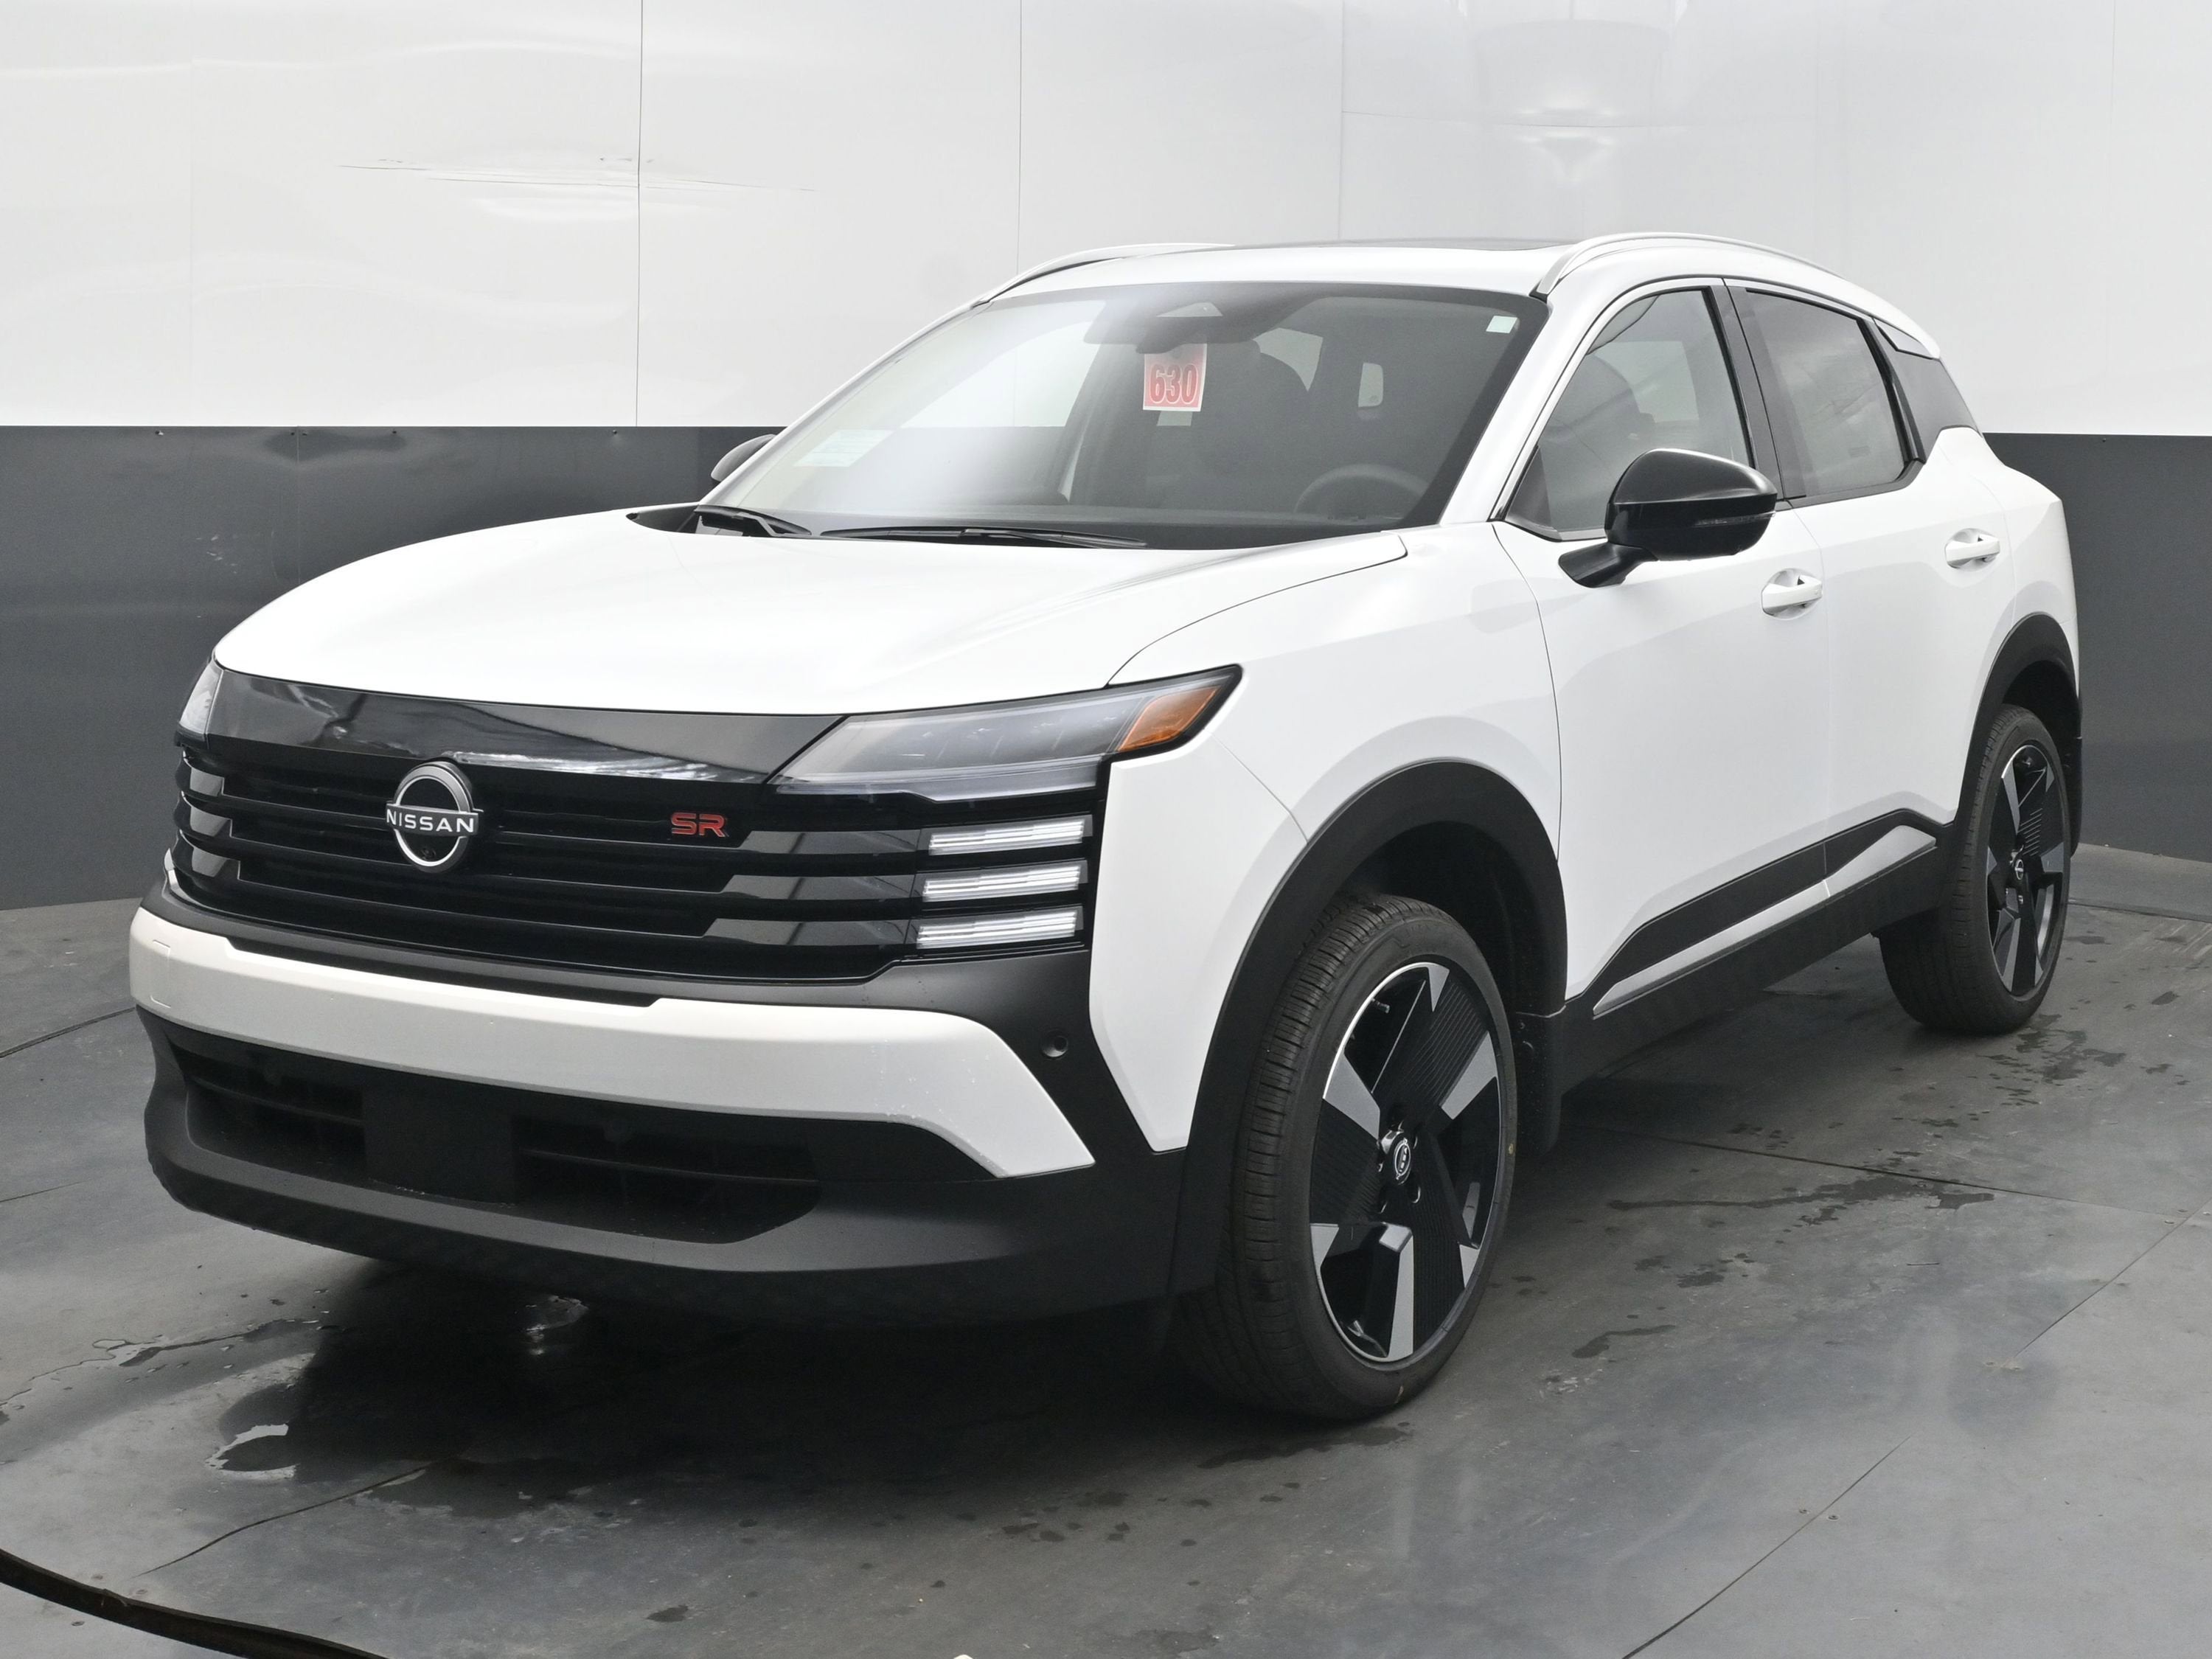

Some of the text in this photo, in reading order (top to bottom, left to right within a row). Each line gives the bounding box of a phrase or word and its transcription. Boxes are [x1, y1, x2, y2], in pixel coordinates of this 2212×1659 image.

[1150, 364, 1198, 405] 630
[386, 808, 474, 833] NISSAN
[671, 812, 726, 838] SR
